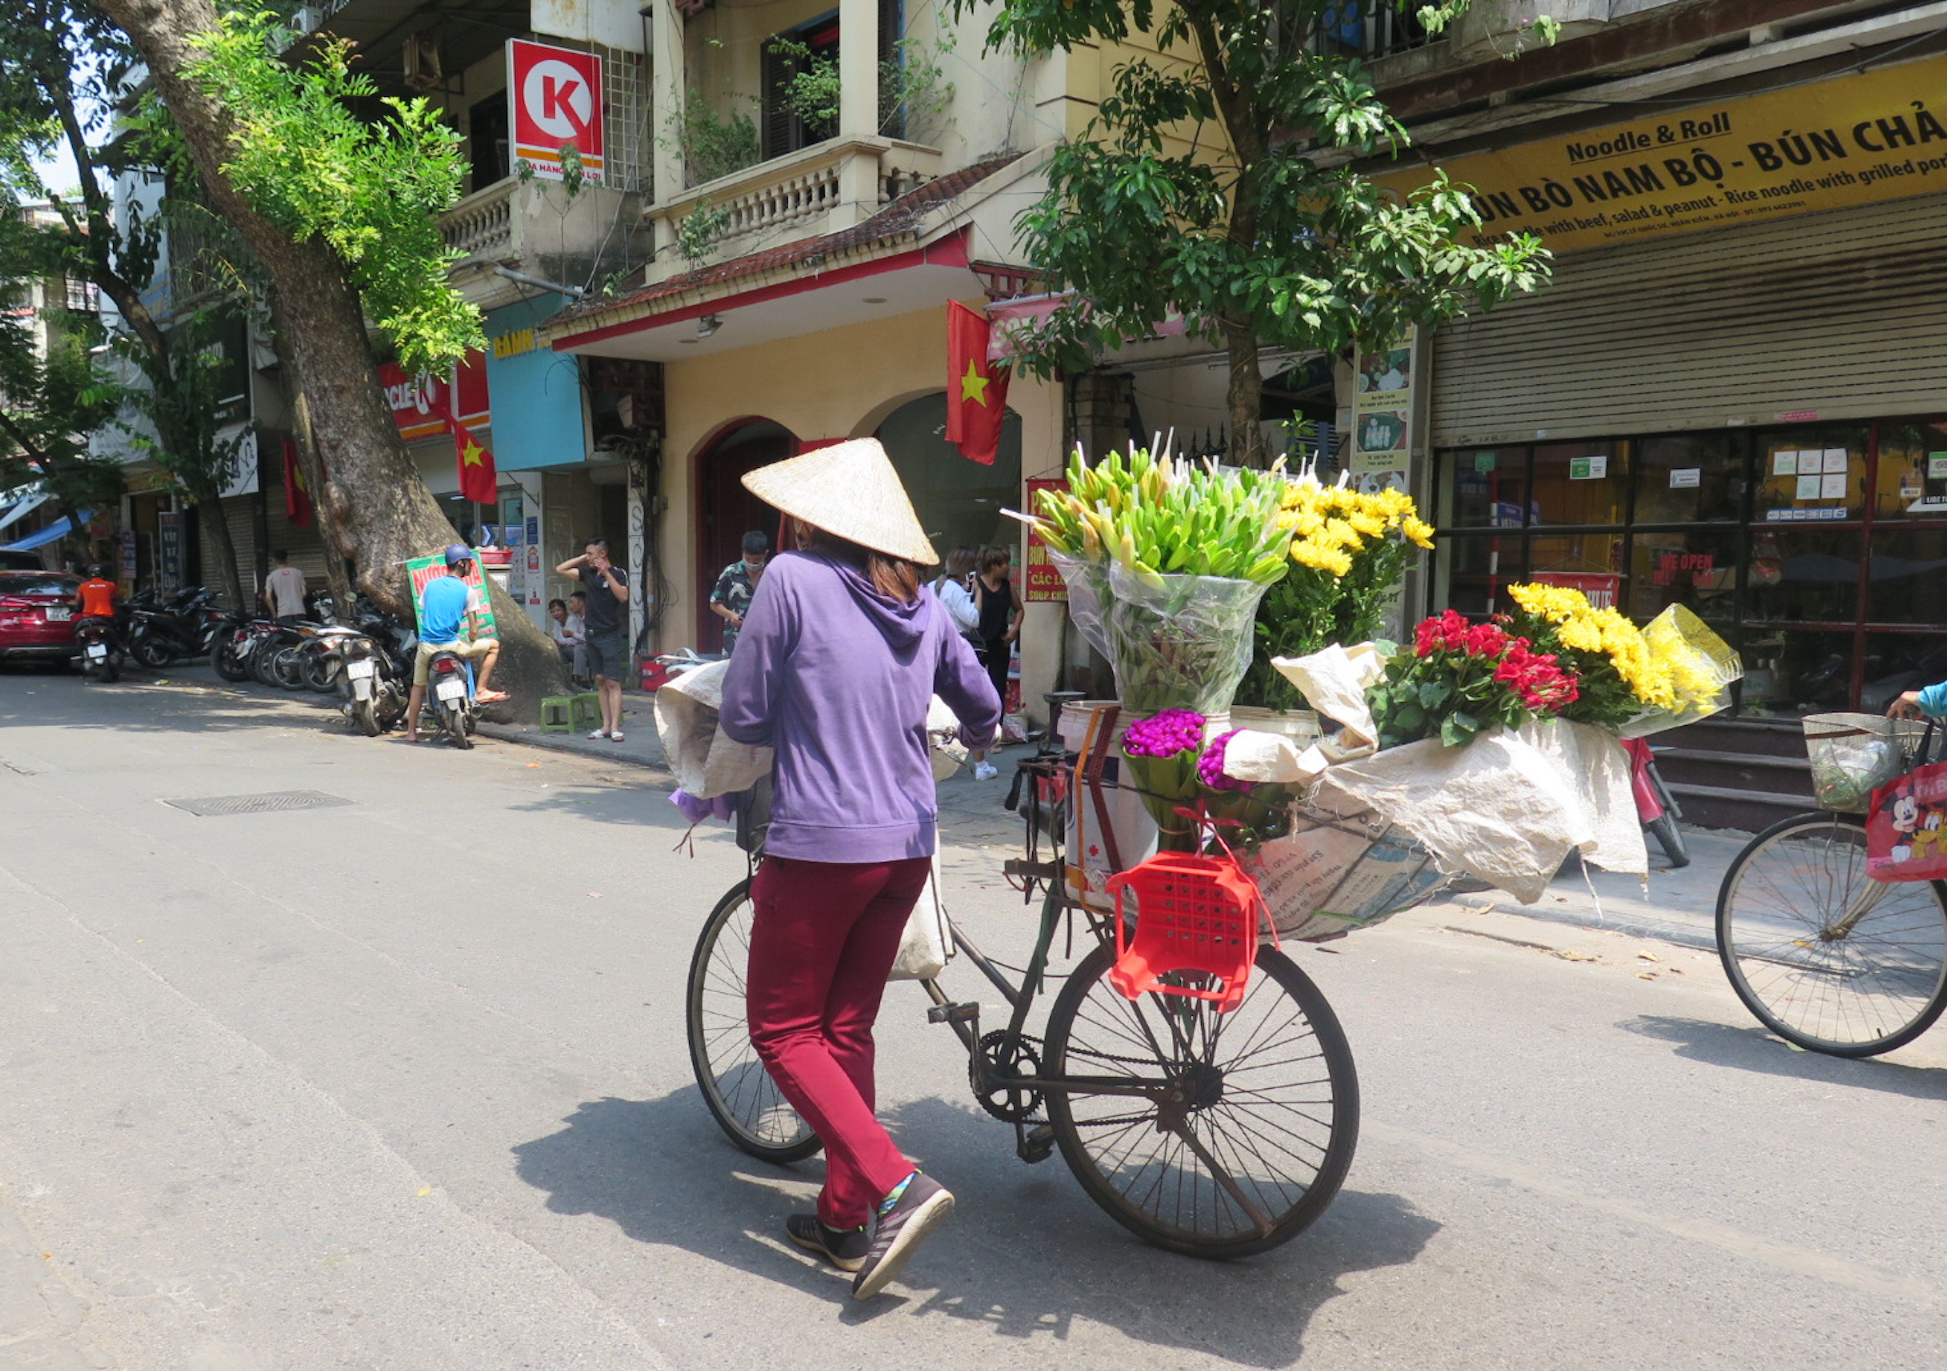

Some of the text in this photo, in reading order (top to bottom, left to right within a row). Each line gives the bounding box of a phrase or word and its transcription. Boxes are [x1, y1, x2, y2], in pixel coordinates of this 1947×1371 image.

[1566, 112, 1731, 162] Noodle & Roll
[1459, 191, 1523, 227] ÚN
[1518, 177, 1574, 213] BÒ
[1572, 164, 1666, 203] NAM
[1663, 147, 1724, 189] BỘ
[1748, 129, 1847, 172] BÚN
[1853, 100, 1947, 152] CHẢ
[1472, 230, 1502, 248] Rice
[1544, 217, 1575, 236] with
[1575, 213, 1613, 231] beef,
[1615, 206, 1650, 224] salad
[1650, 204, 1665, 217] &
[1665, 195, 1718, 219] peanut
[1724, 189, 1757, 204] Rice
[1760, 179, 1816, 199] noodle
[1816, 170, 1856, 189] with
[1858, 159, 1915, 185] grilled
[1917, 153, 1947, 175] por
[493, 328, 534, 359] BÁNH
[1681, 554, 1713, 570] OPEN
